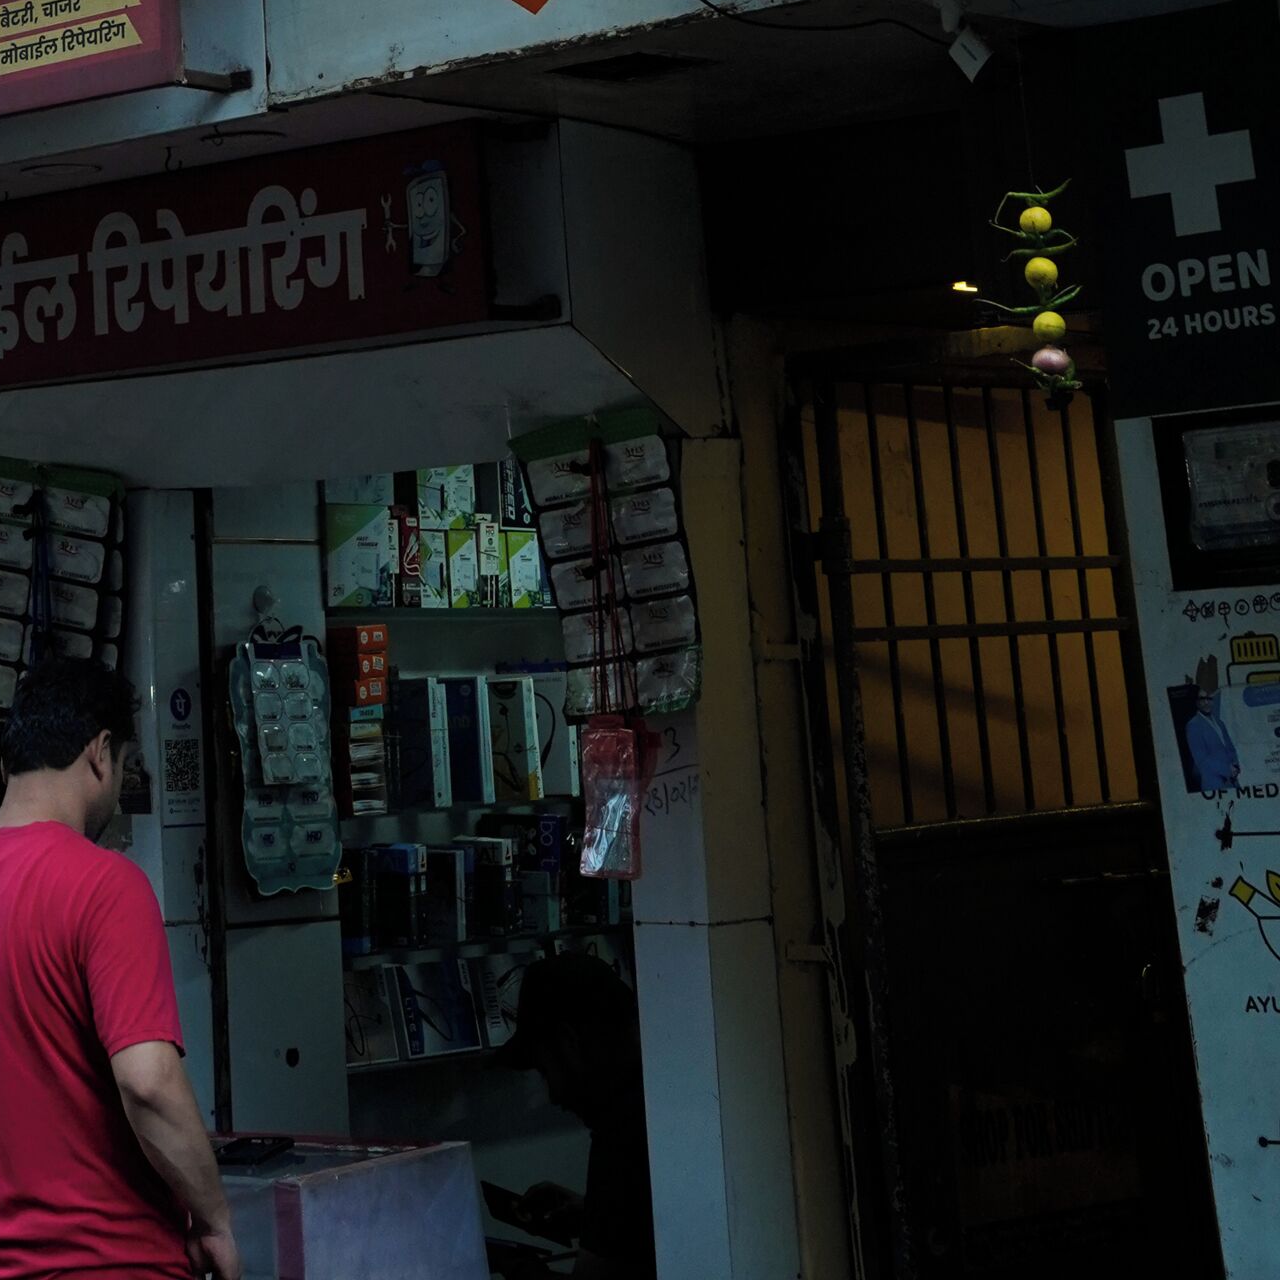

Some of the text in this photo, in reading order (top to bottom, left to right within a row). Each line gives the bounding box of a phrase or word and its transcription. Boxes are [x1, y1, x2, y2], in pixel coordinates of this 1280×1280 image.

[0, 19, 126, 65] मोबाईल रिपेयरिंग
[87, 184, 369, 336] रिपेयरिंग
[1140, 248, 1273, 303] OPEN
[1147, 301, 1277, 340] 24 HOURS
